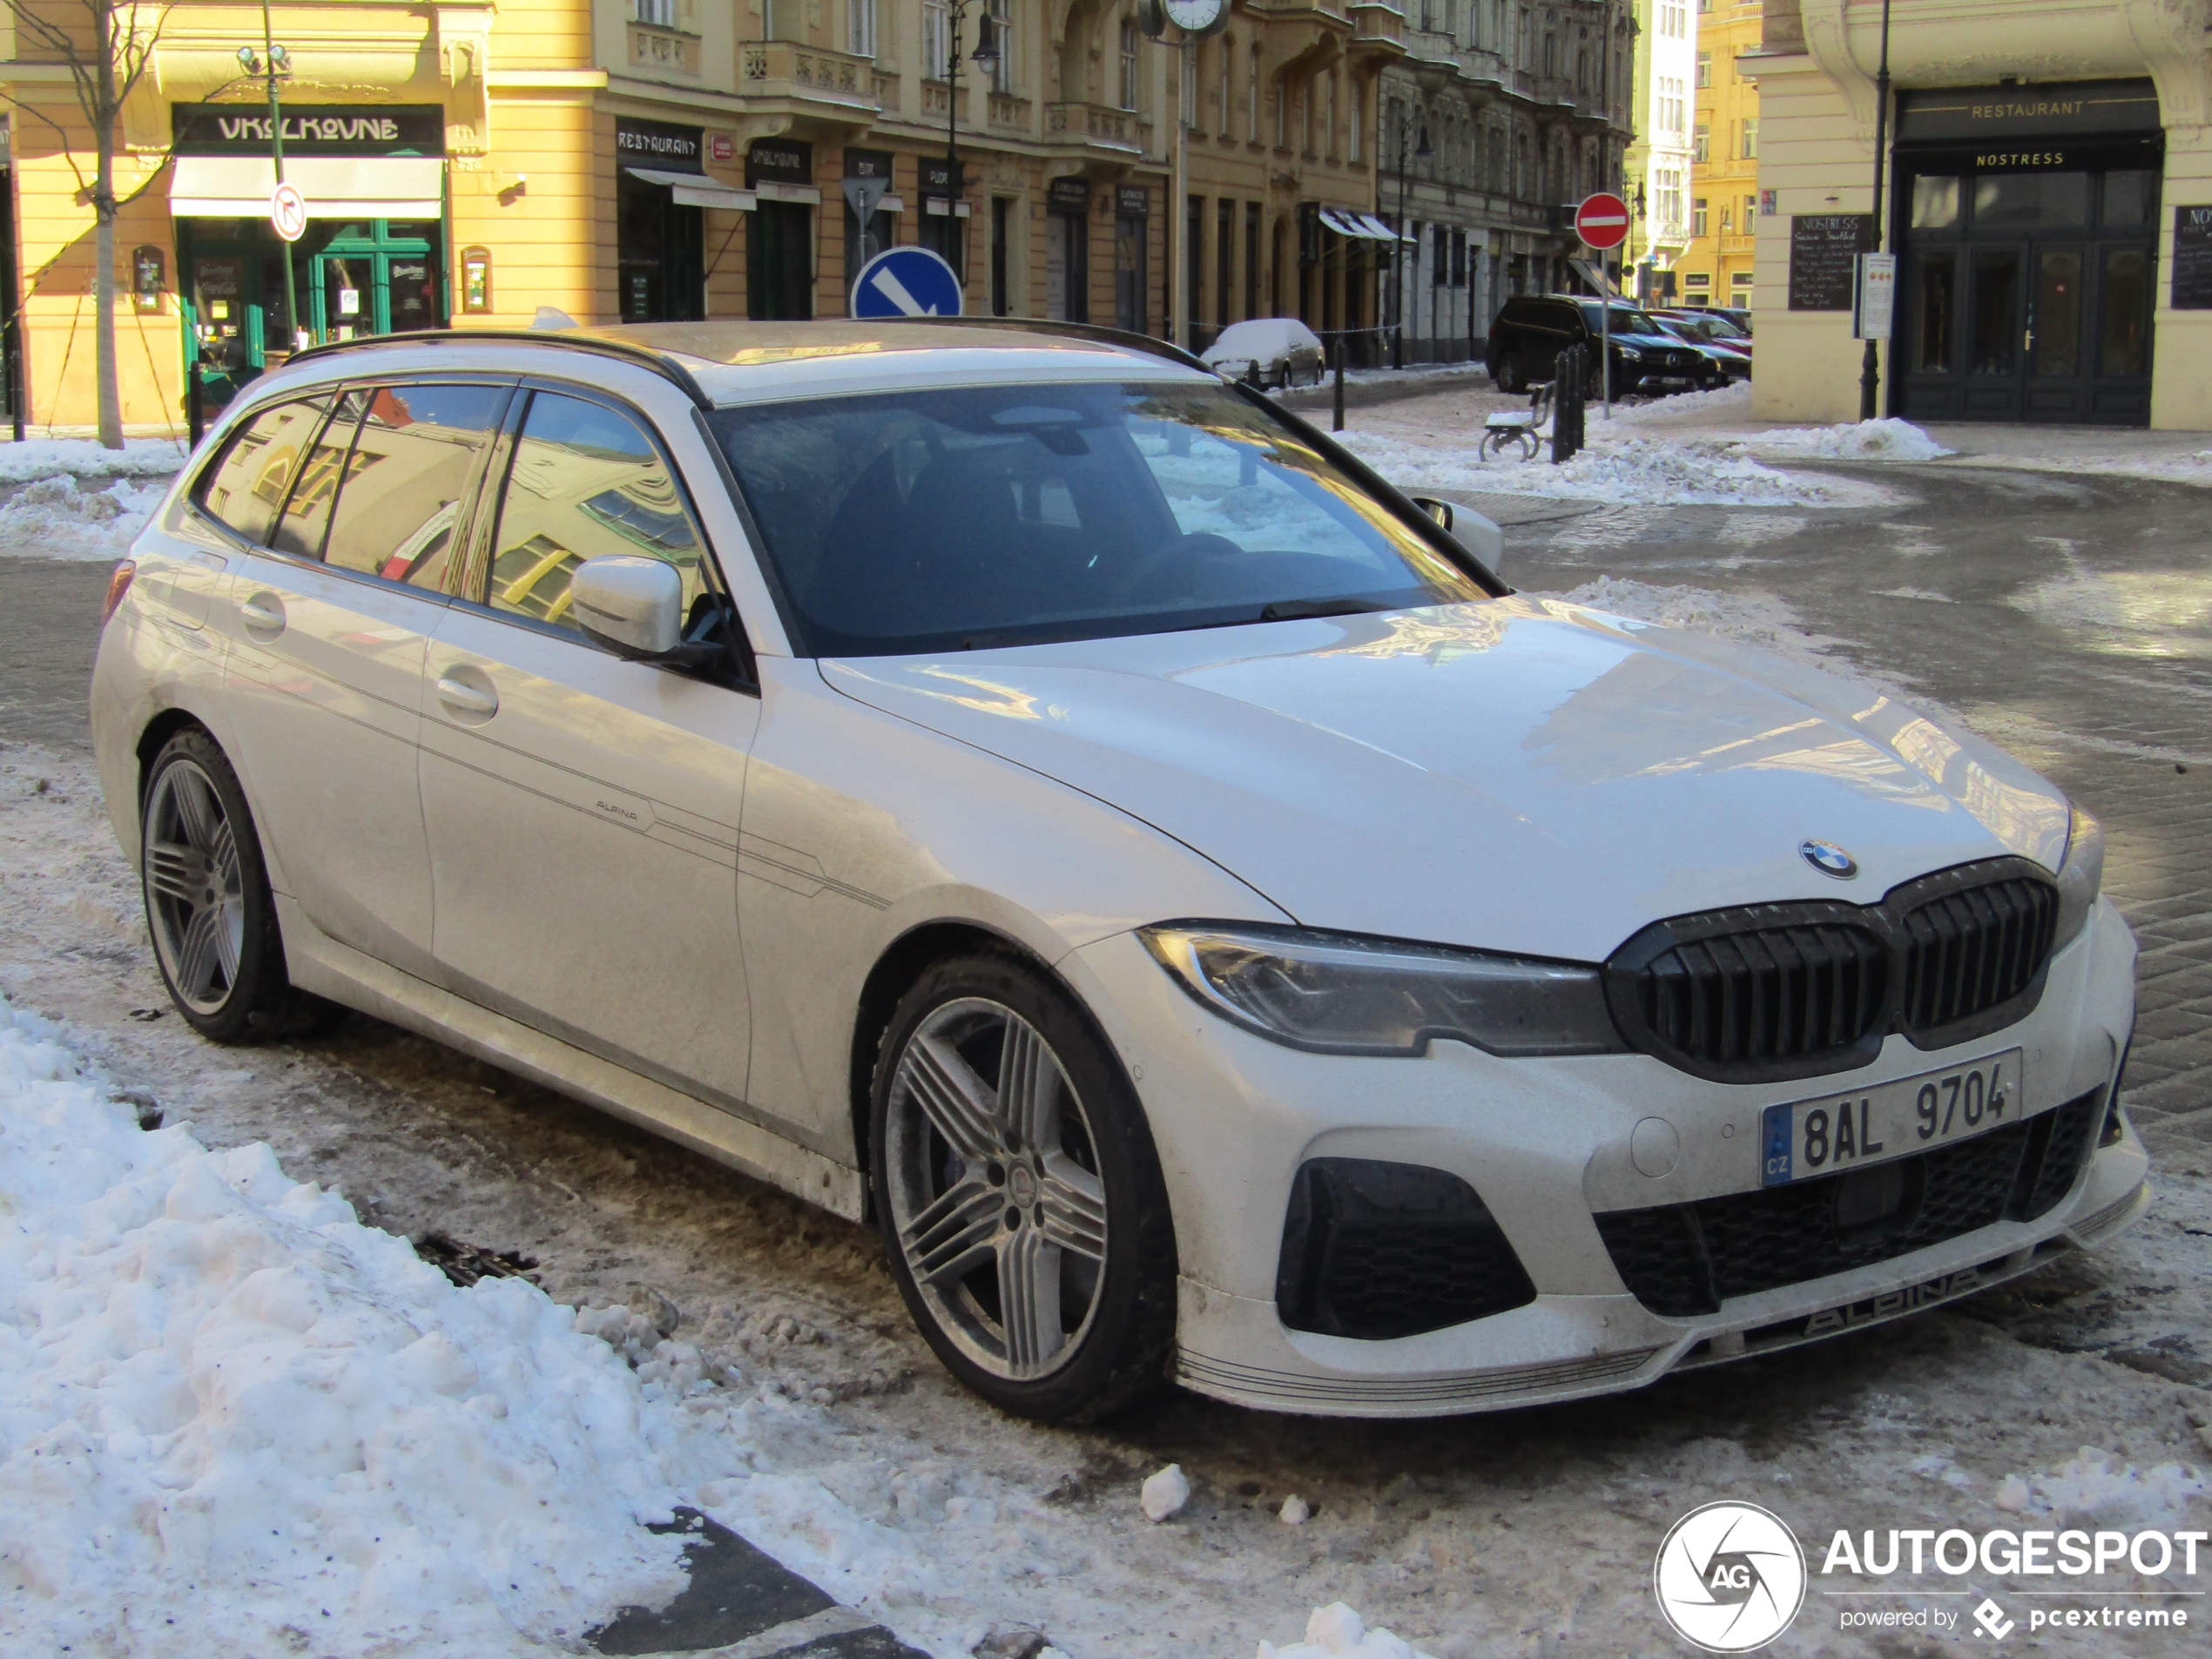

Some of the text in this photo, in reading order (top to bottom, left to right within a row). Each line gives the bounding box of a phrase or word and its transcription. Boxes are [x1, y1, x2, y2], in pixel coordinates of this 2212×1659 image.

[1972, 101, 2084, 118] RESTAURANT
[618, 132, 696, 156] RESTAURANT
[1976, 152, 2064, 166] NOSTRESS
[2189, 208, 2212, 225] NO
[597, 800, 637, 821] ALPINA
[1804, 1062, 2006, 1168] 8AL 9704
[1766, 1156, 1789, 1176] CZ
[1803, 1267, 1982, 1336] ALPINA
